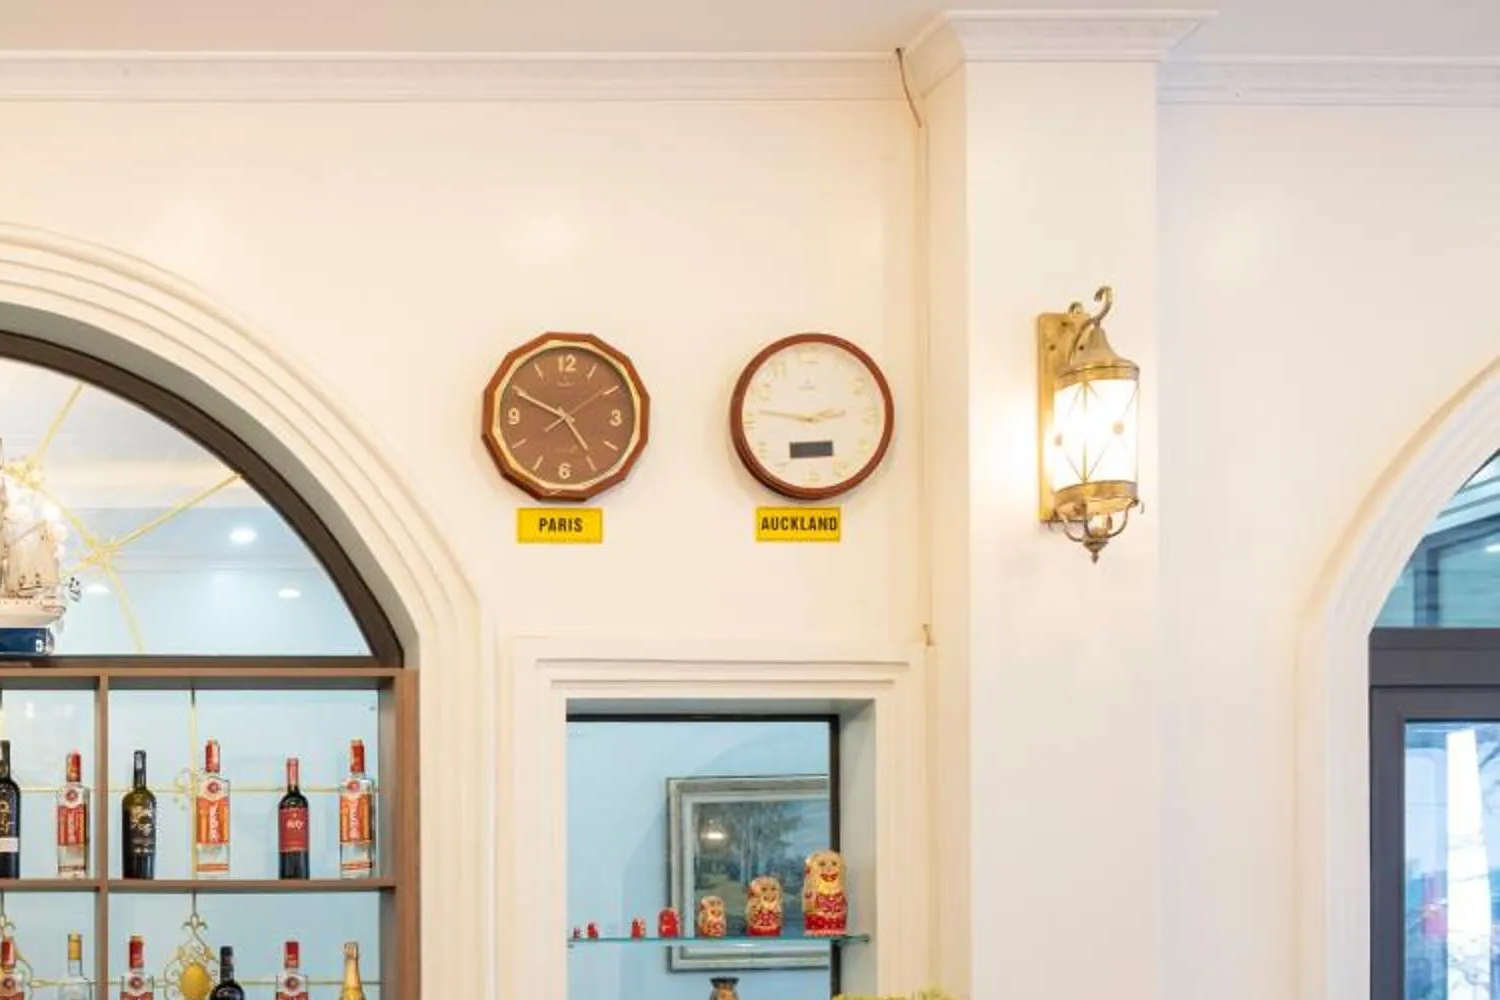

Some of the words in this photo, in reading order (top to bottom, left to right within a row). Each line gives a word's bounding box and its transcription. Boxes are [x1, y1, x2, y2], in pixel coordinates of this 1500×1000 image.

[557, 354, 577, 373] 12
[507, 407, 521, 426] 9
[609, 408, 623, 427] 3
[558, 463, 572, 480] 6
[539, 516, 584, 532] PARIS
[761, 516, 838, 531] AUCKLAND
